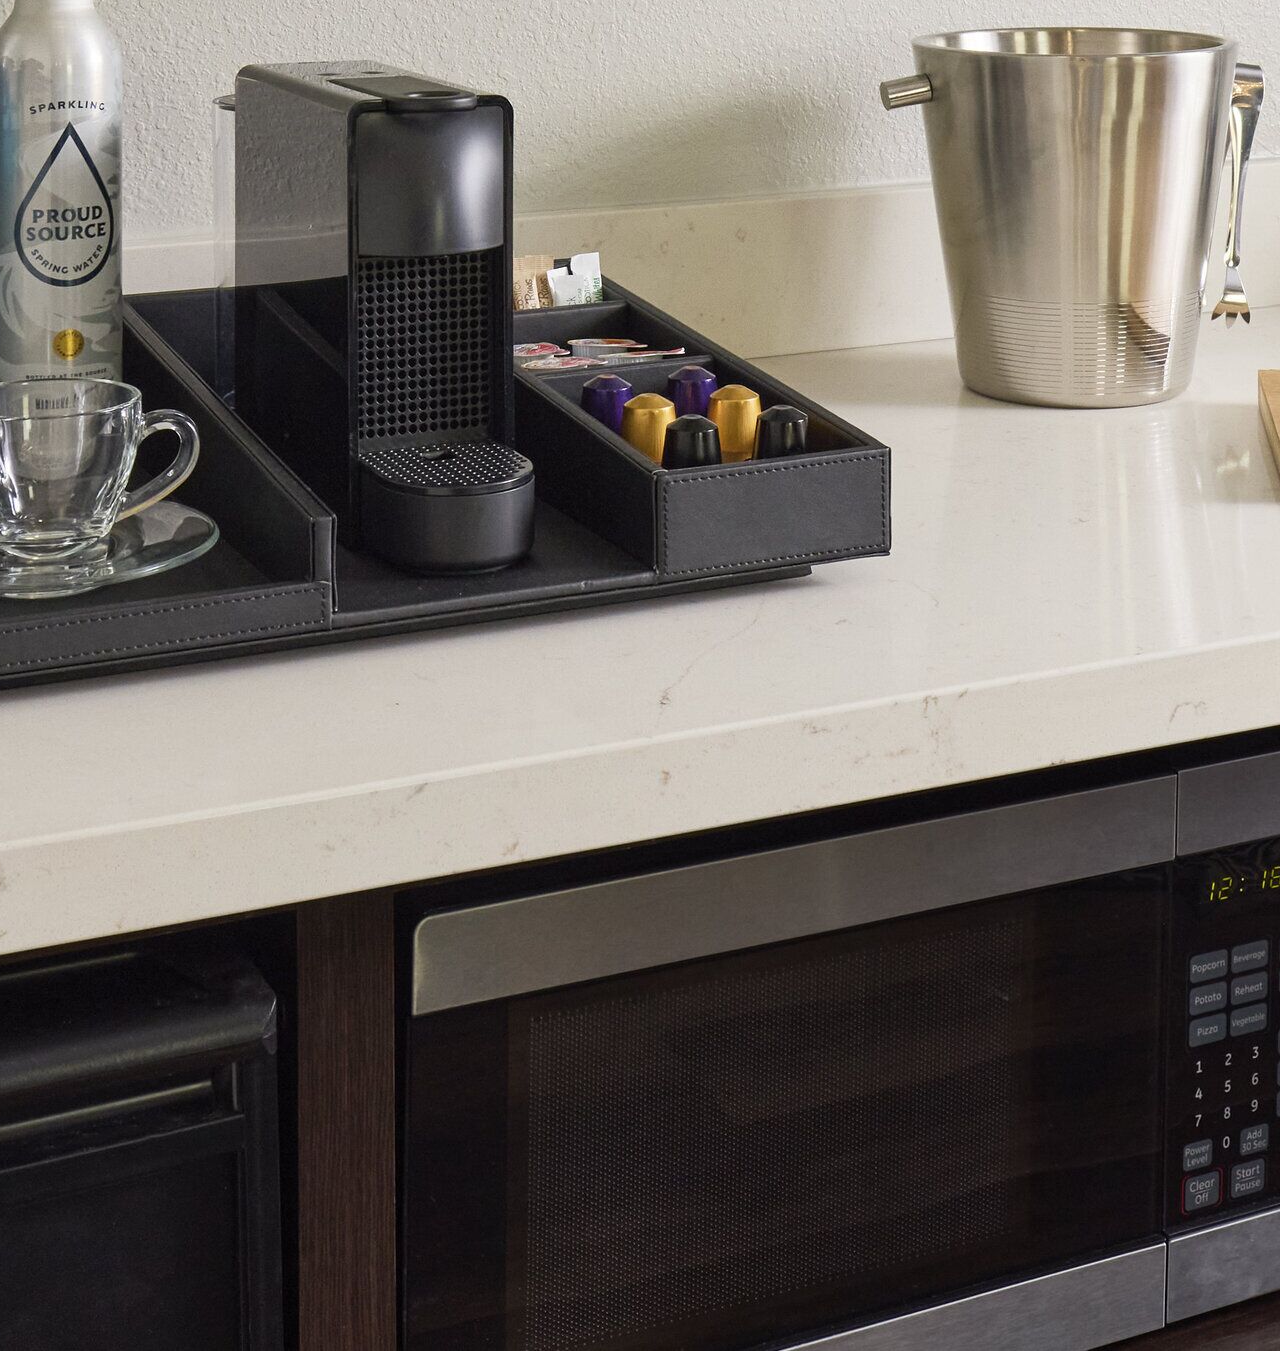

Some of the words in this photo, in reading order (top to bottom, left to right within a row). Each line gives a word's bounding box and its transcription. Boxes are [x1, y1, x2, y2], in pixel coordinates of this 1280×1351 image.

[29, 100, 105, 114] SPARKLING
[32, 205, 103, 223] PROUD
[26, 222, 107, 242] SOURCE
[31, 248, 69, 274] SPRING
[73, 244, 103, 273] WATER
[1233, 949, 1266, 964] Beverage
[1192, 959, 1226, 974] Popcorn
[1234, 982, 1263, 996] Reheat
[1194, 992, 1222, 1006] Potato
[1231, 1012, 1266, 1028] Vegetable
[1197, 1024, 1218, 1037] Pizza
[1225, 1053, 1232, 1066] 2
[1252, 1046, 1259, 1059] 3
[1196, 1061, 1203, 1074] 1
[1251, 1072, 1259, 1085] 6
[1224, 1079, 1231, 1093] 5
[1195, 1087, 1203, 1100] 4
[1251, 1099, 1258, 1112] 9
[1223, 1107, 1231, 1119] 8
[1195, 1114, 1202, 1127] 7
[1246, 1128, 1262, 1141] Add
[1222, 1136, 1230, 1149] 0
[1242, 1142, 1252, 1153] 30
[1252, 1138, 1266, 1150] Sec
[1184, 1143, 1210, 1157] Power
[1187, 1152, 1208, 1167] Level
[1236, 1164, 1260, 1180] Start
[1189, 1178, 1215, 1193] Clear
[1235, 1178, 1261, 1192] Pause
[1195, 1192, 1209, 1205] Off
